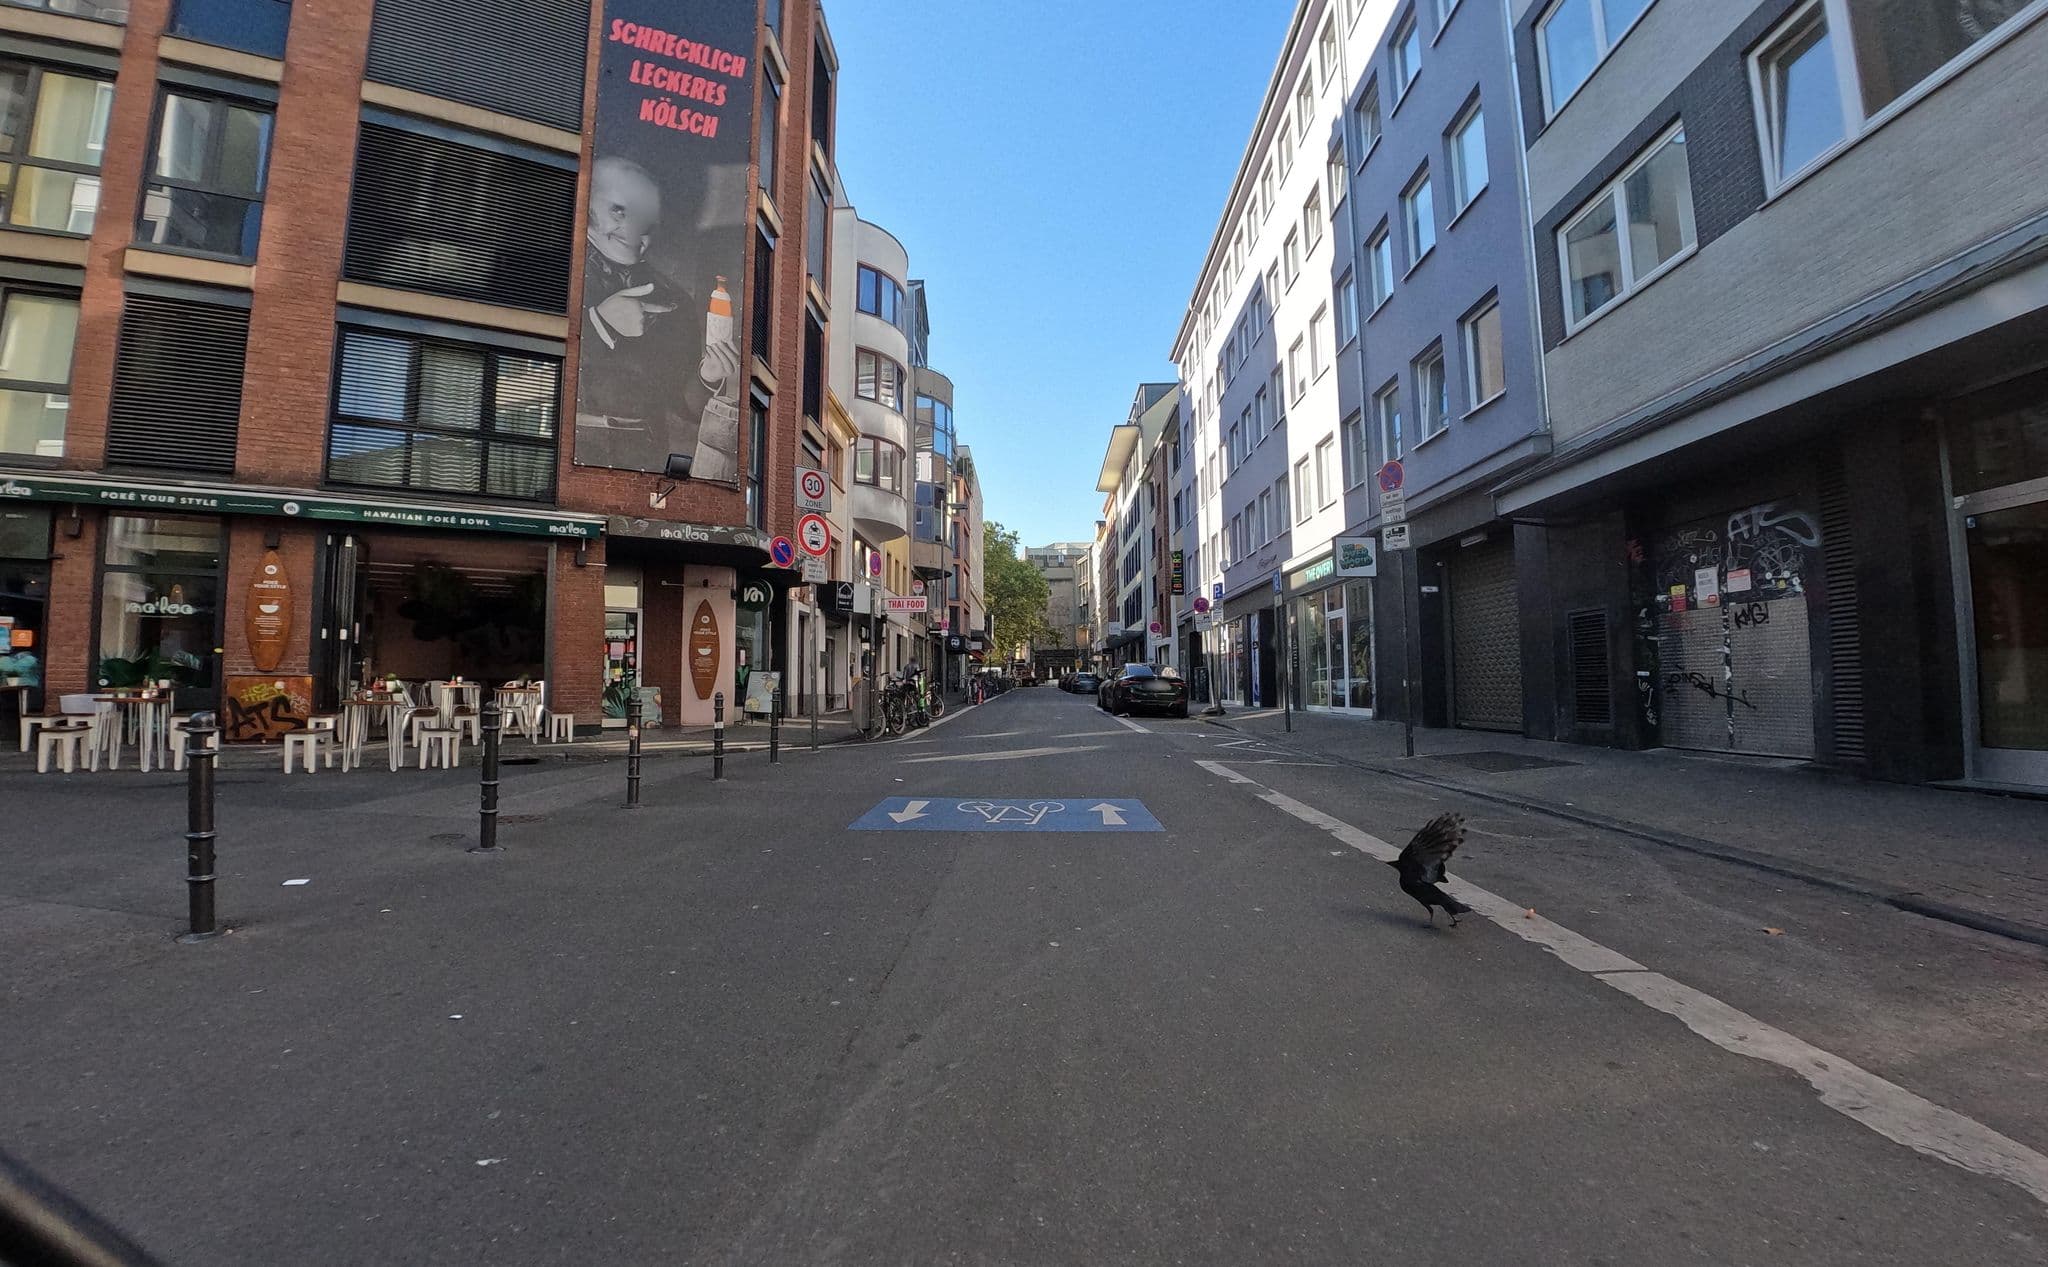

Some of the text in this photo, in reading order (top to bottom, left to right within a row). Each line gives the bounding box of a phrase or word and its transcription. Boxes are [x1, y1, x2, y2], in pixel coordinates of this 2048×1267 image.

[609, 19, 747, 78] SCHRECKLICH
[629, 60, 727, 106] LECKERES
[639, 97, 719, 138] KÖLSCH
[807, 478, 820, 492] 30
[101, 491, 218, 507] POKÉ YOUR STYLE
[805, 499, 823, 508] ZONE
[363, 510, 491, 527] HAWAIIAN POKÉ BOWL
[1172, 553, 1182, 588] BUTLERS
[888, 600, 925, 609] THAI FOOD
